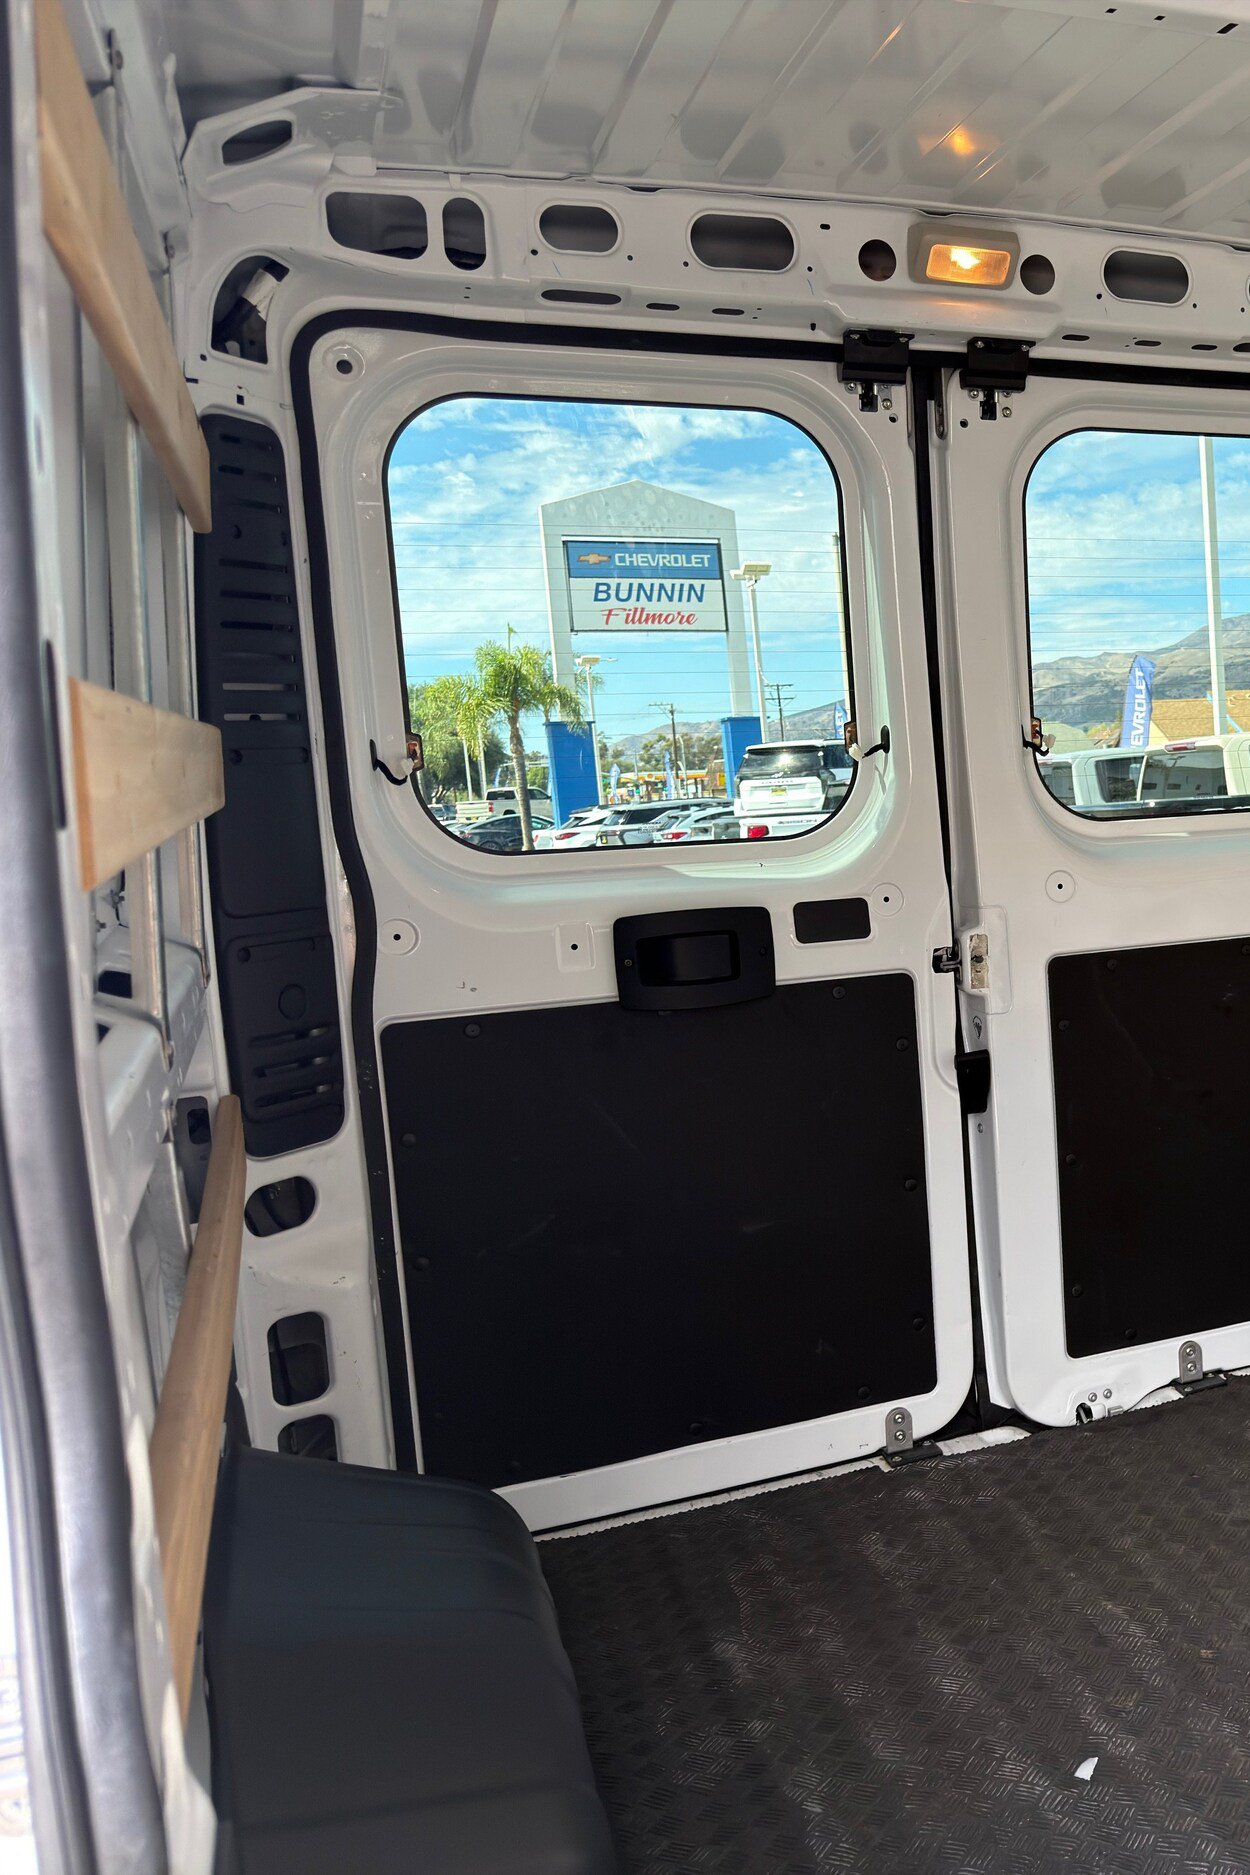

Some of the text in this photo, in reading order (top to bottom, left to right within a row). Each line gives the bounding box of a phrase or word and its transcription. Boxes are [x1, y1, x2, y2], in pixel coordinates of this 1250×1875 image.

[615, 553, 711, 567] CHEVROLET
[593, 582, 705, 602] BUNNIN
[601, 607, 698, 625] Fillmore
[1130, 666, 1147, 748] EVROLET
